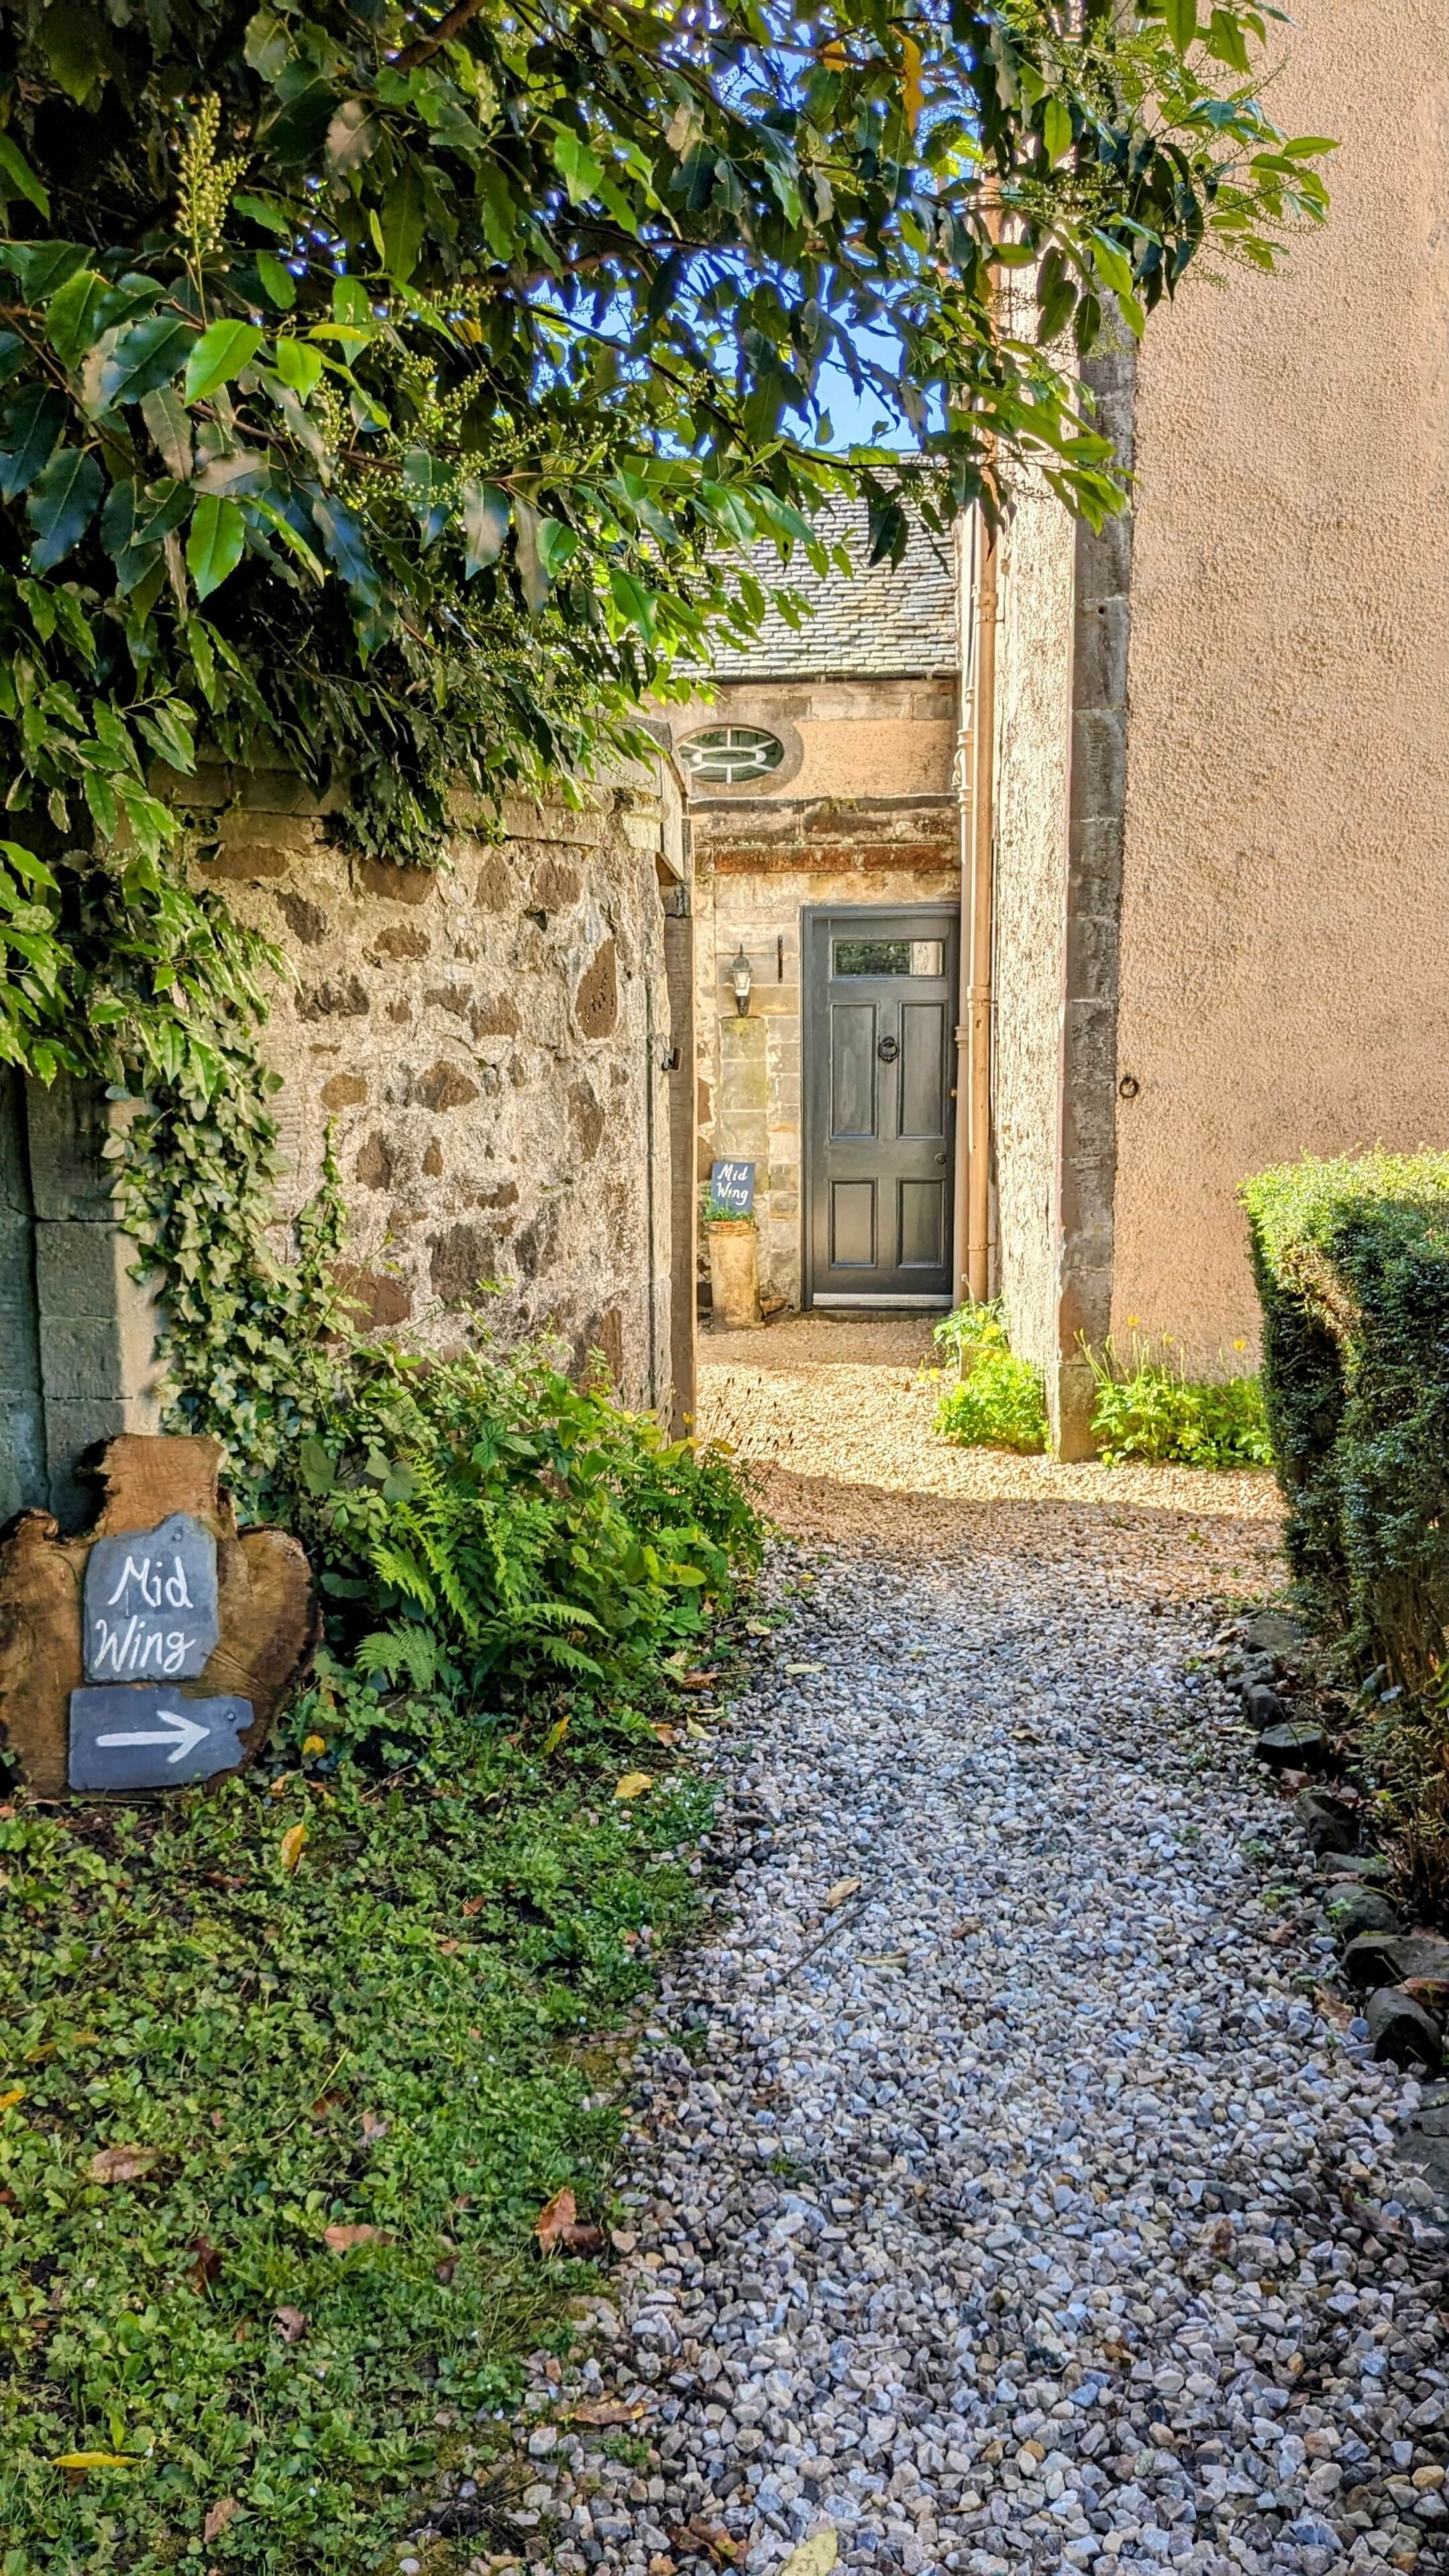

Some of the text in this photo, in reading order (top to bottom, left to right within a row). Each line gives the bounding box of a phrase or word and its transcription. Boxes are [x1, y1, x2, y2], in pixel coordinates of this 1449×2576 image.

[717, 1163, 749, 1181] Mid
[716, 1182, 749, 1205] Wing
[107, 1556, 193, 1609] Mid
[94, 1615, 196, 1673] Wing
